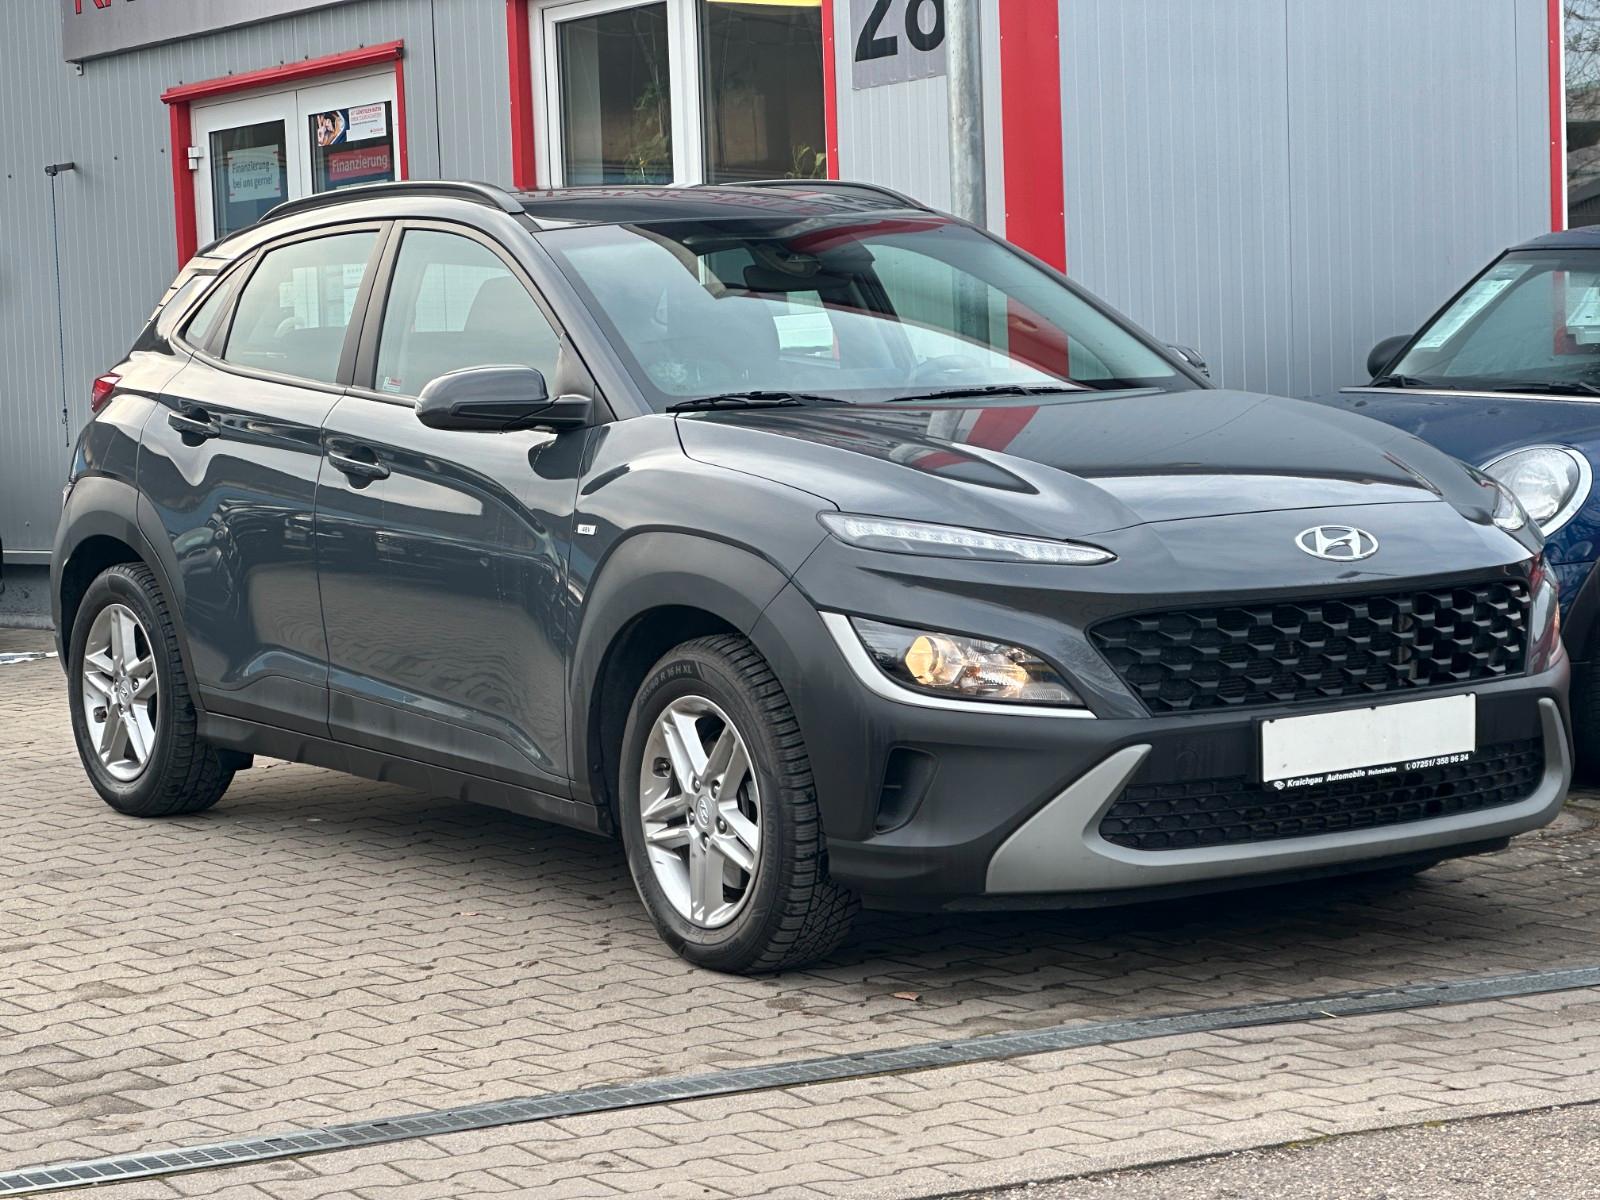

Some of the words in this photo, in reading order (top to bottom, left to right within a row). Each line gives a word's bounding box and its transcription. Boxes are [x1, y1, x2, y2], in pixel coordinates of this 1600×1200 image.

[232, 161, 269, 173] Finanzierung
[332, 154, 388, 173] Finanzierung
[682, 664, 693, 674] XL
[1287, 776, 1323, 788] Kraichgau
[1326, 770, 1366, 782] Automobile
[1411, 758, 1436, 769] 07251/
[1436, 756, 1449, 766] 358
[1450, 755, 1459, 764] 96
[1460, 753, 1469, 761] 24
